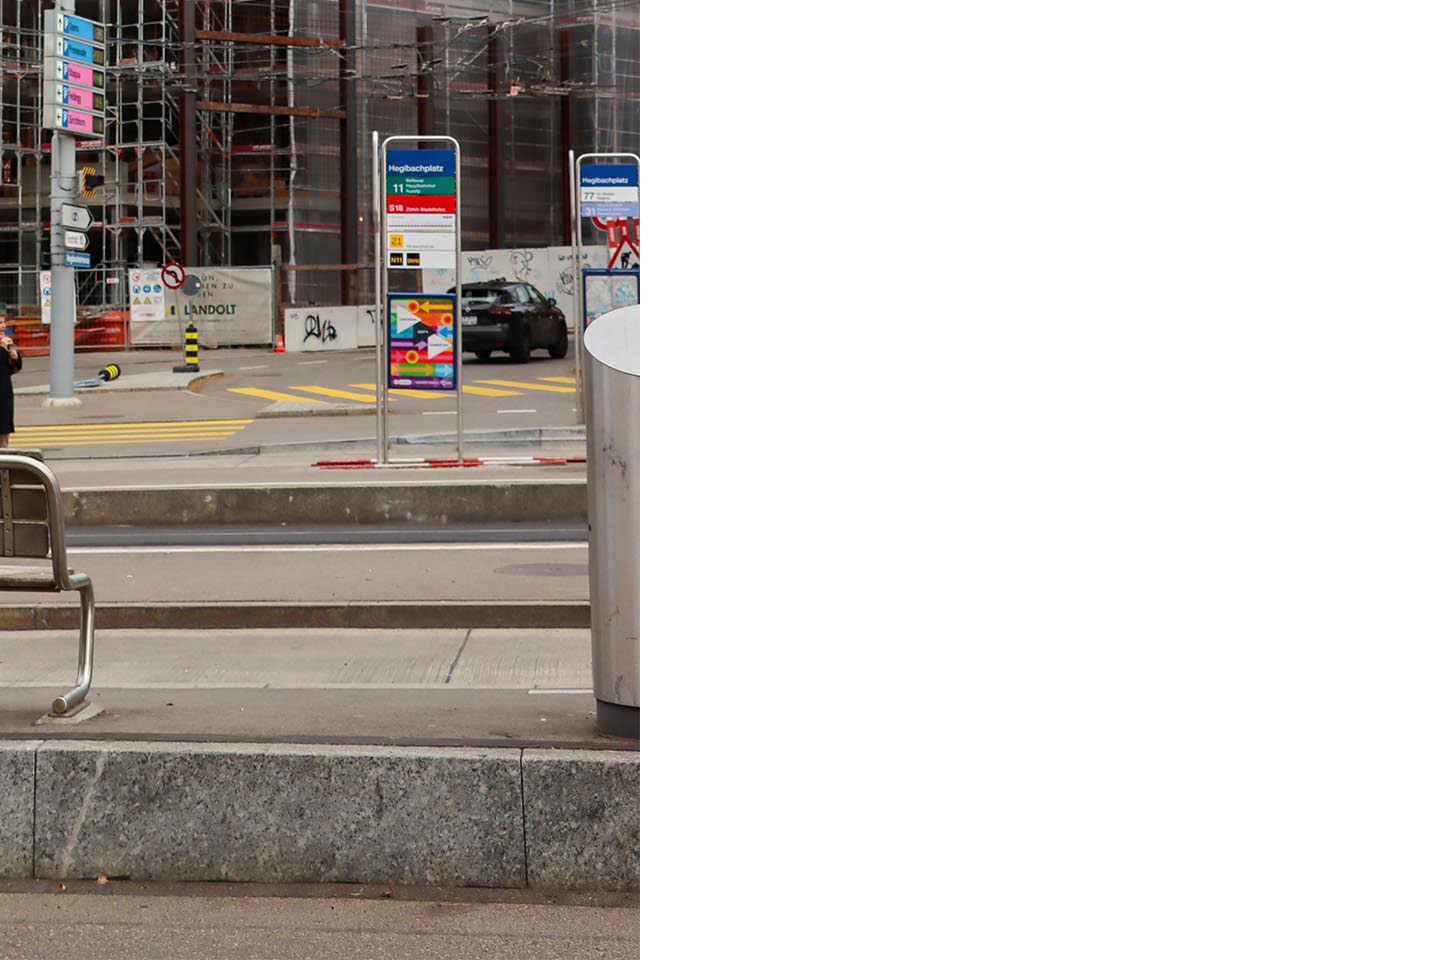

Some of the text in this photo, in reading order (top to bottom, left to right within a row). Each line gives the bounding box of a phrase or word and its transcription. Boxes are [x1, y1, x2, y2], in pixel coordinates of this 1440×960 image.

[388, 164, 444, 173] Hegibachplatz
[582, 177, 628, 185] Hegibachplatz
[393, 183, 403, 193] 11
[584, 192, 595, 200] 77
[389, 204, 403, 212] S18
[391, 237, 401, 246] 21
[184, 304, 237, 315] LANDOLT
